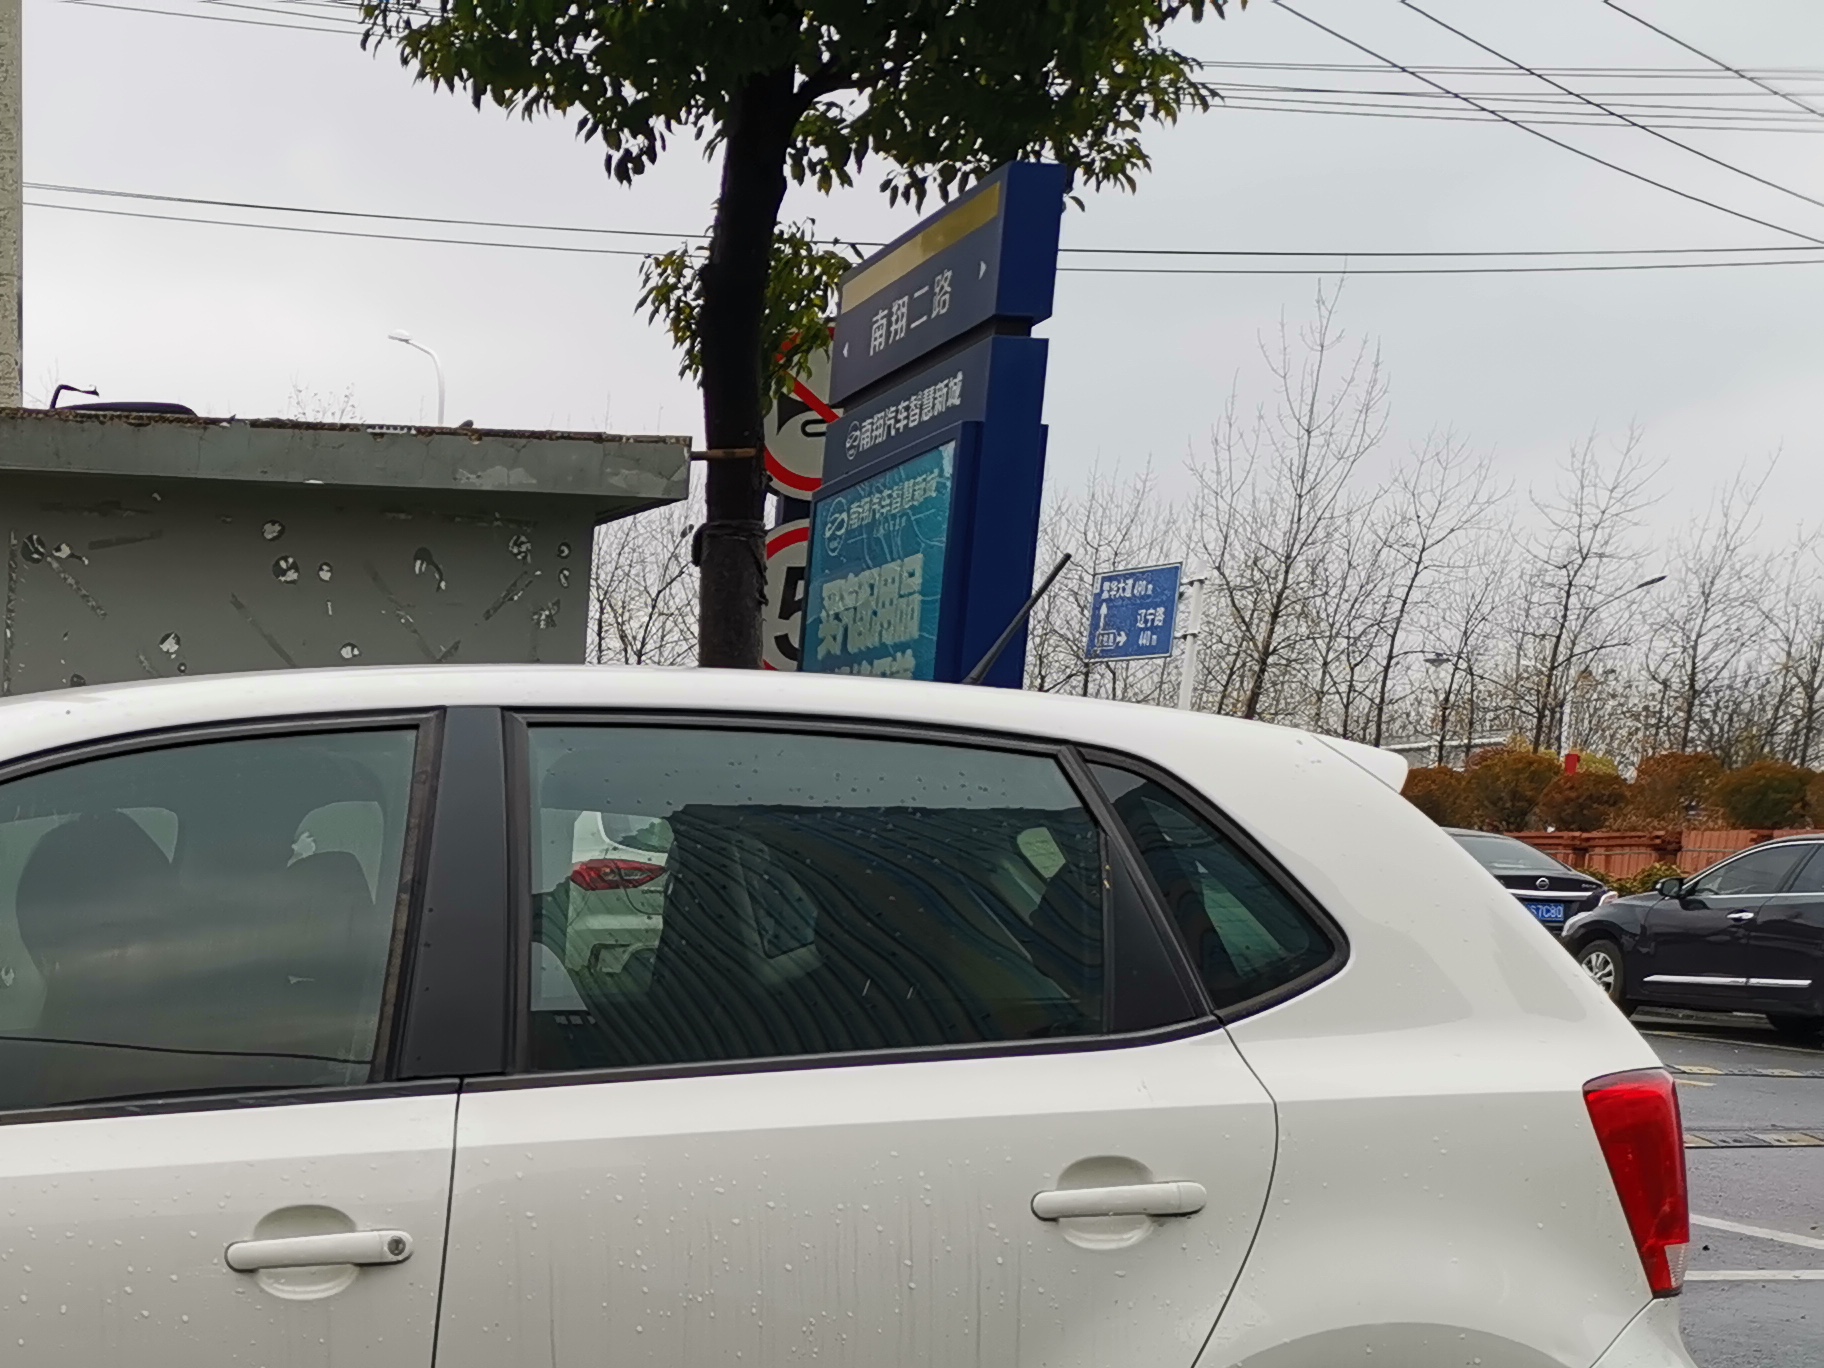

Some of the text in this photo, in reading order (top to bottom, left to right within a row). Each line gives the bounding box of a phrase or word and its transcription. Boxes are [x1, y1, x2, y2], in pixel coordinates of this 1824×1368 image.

[869, 268, 954, 357] 南翔二路
[858, 370, 964, 452] 南翔汽车智慧新城
